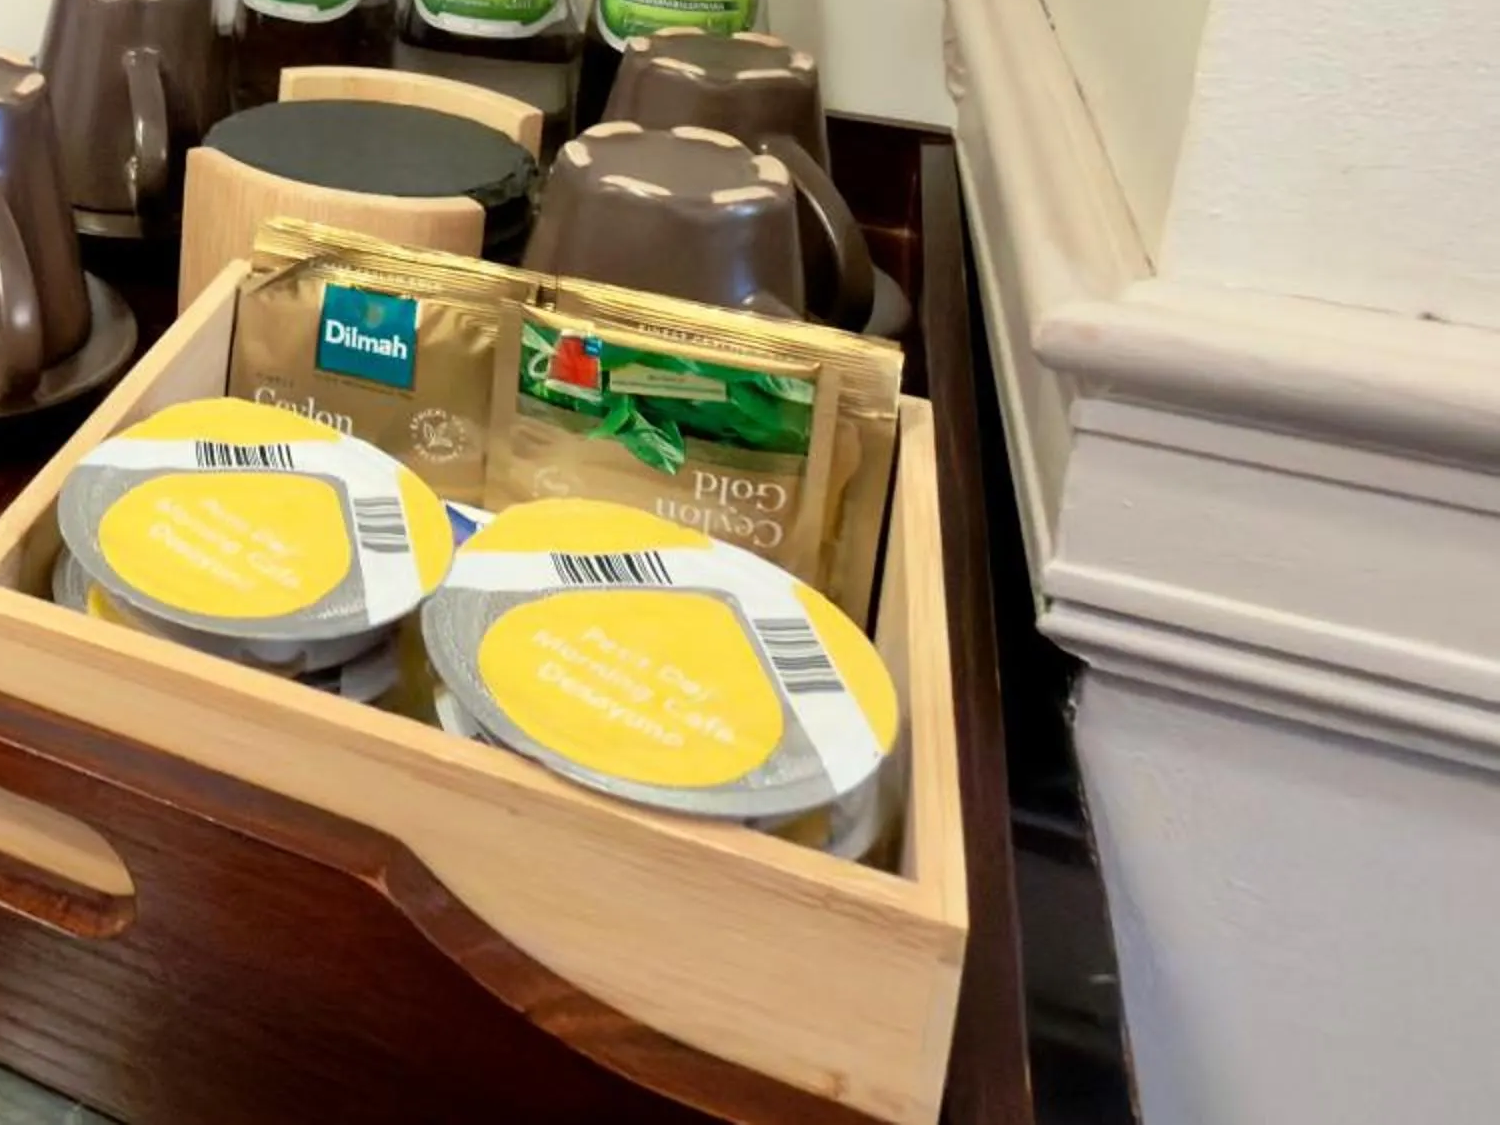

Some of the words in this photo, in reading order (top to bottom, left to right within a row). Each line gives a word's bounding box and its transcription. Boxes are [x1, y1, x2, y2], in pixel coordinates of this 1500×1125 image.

[324, 318, 408, 361] Dilmah
[692, 469, 787, 513] Gold
[655, 497, 783, 549] Ceylon
[531, 628, 656, 704] Morning
[536, 659, 686, 749] Desayuno
